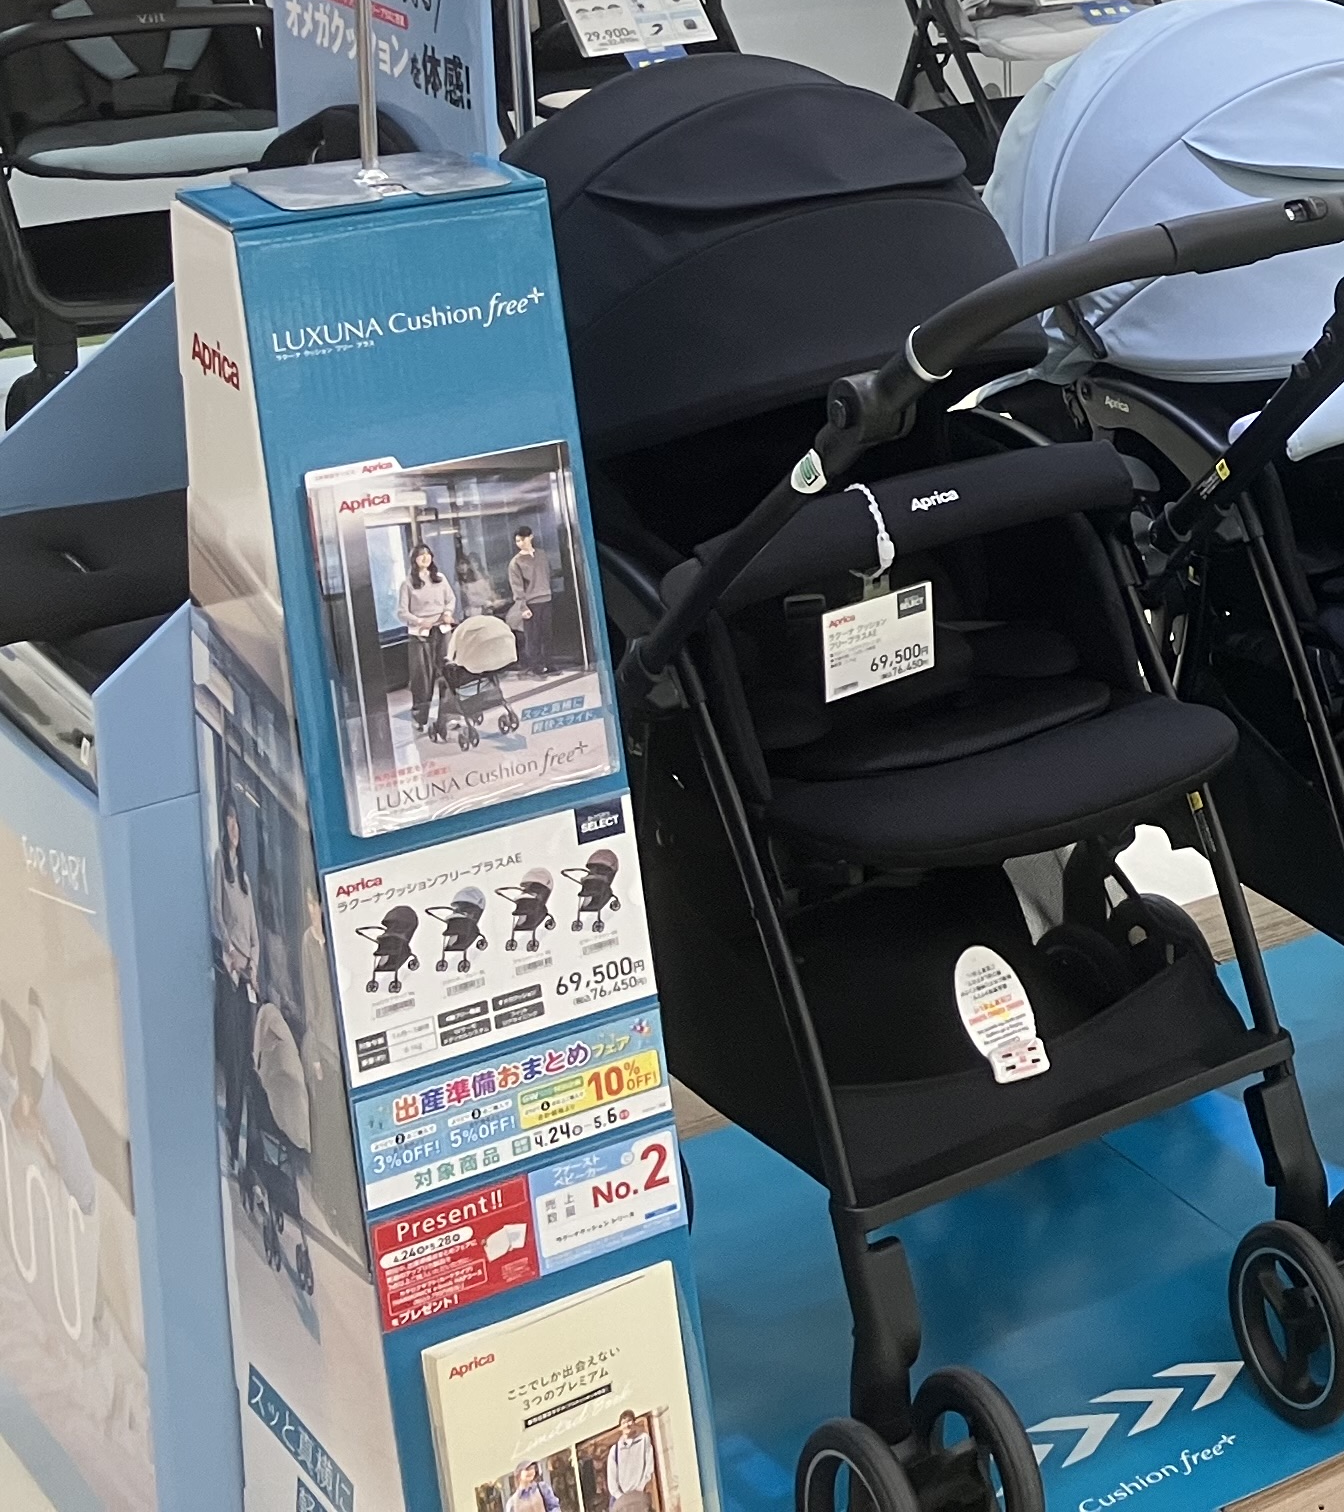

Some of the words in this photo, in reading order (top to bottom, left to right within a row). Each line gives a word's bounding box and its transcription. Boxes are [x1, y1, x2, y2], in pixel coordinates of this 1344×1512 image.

[272, 317, 384, 354] LUXUNA
[388, 304, 482, 335] Cushion
[191, 332, 240, 391] Aprica
[361, 461, 393, 474] Aprica
[338, 491, 391, 514] Aprica
[911, 489, 960, 512] Aprica
[829, 614, 856, 628] Aprica
[869, 643, 929, 672] 69,500円
[376, 777, 460, 812] LUXUNA
[465, 760, 538, 788] Cushion
[580, 814, 620, 833] SELECT
[335, 875, 383, 898] Aprica
[555, 956, 645, 997] 69,500円
[414, 1146, 501, 1190] 対象商品
[396, 1189, 504, 1242] Present!!
[448, 1352, 495, 1380] Aprica
[507, 1345, 621, 1401] ここでしか出会えない
[522, 1367, 610, 1411] 3つのプレミアム
[1078, 1459, 1179, 1512] Cushion
